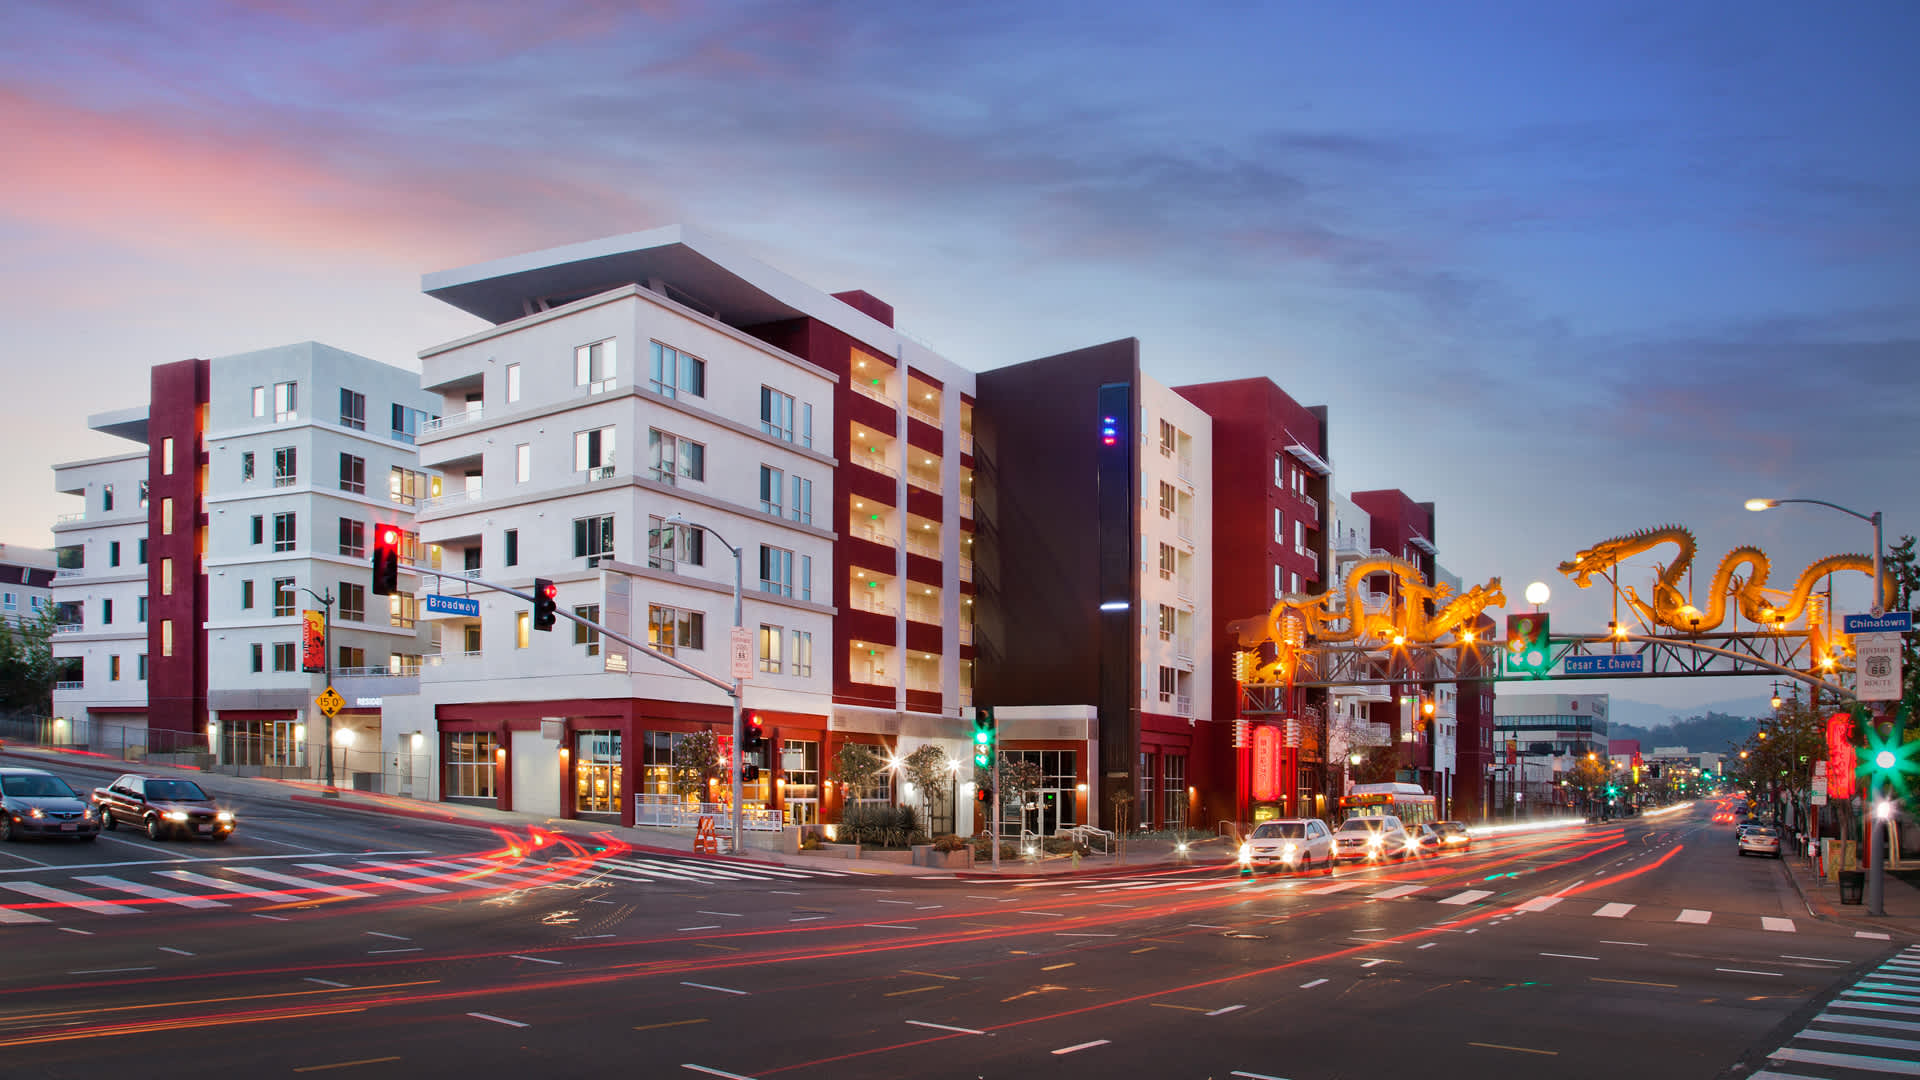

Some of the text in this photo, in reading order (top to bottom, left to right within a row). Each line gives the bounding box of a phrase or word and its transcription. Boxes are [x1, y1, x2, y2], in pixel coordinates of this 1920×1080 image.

[430, 597, 477, 614] Broadway
[1850, 619, 1906, 628] Chinatown
[1567, 658, 1641, 671] Cesar E. Chavez
[1871, 665, 1886, 675] 66
